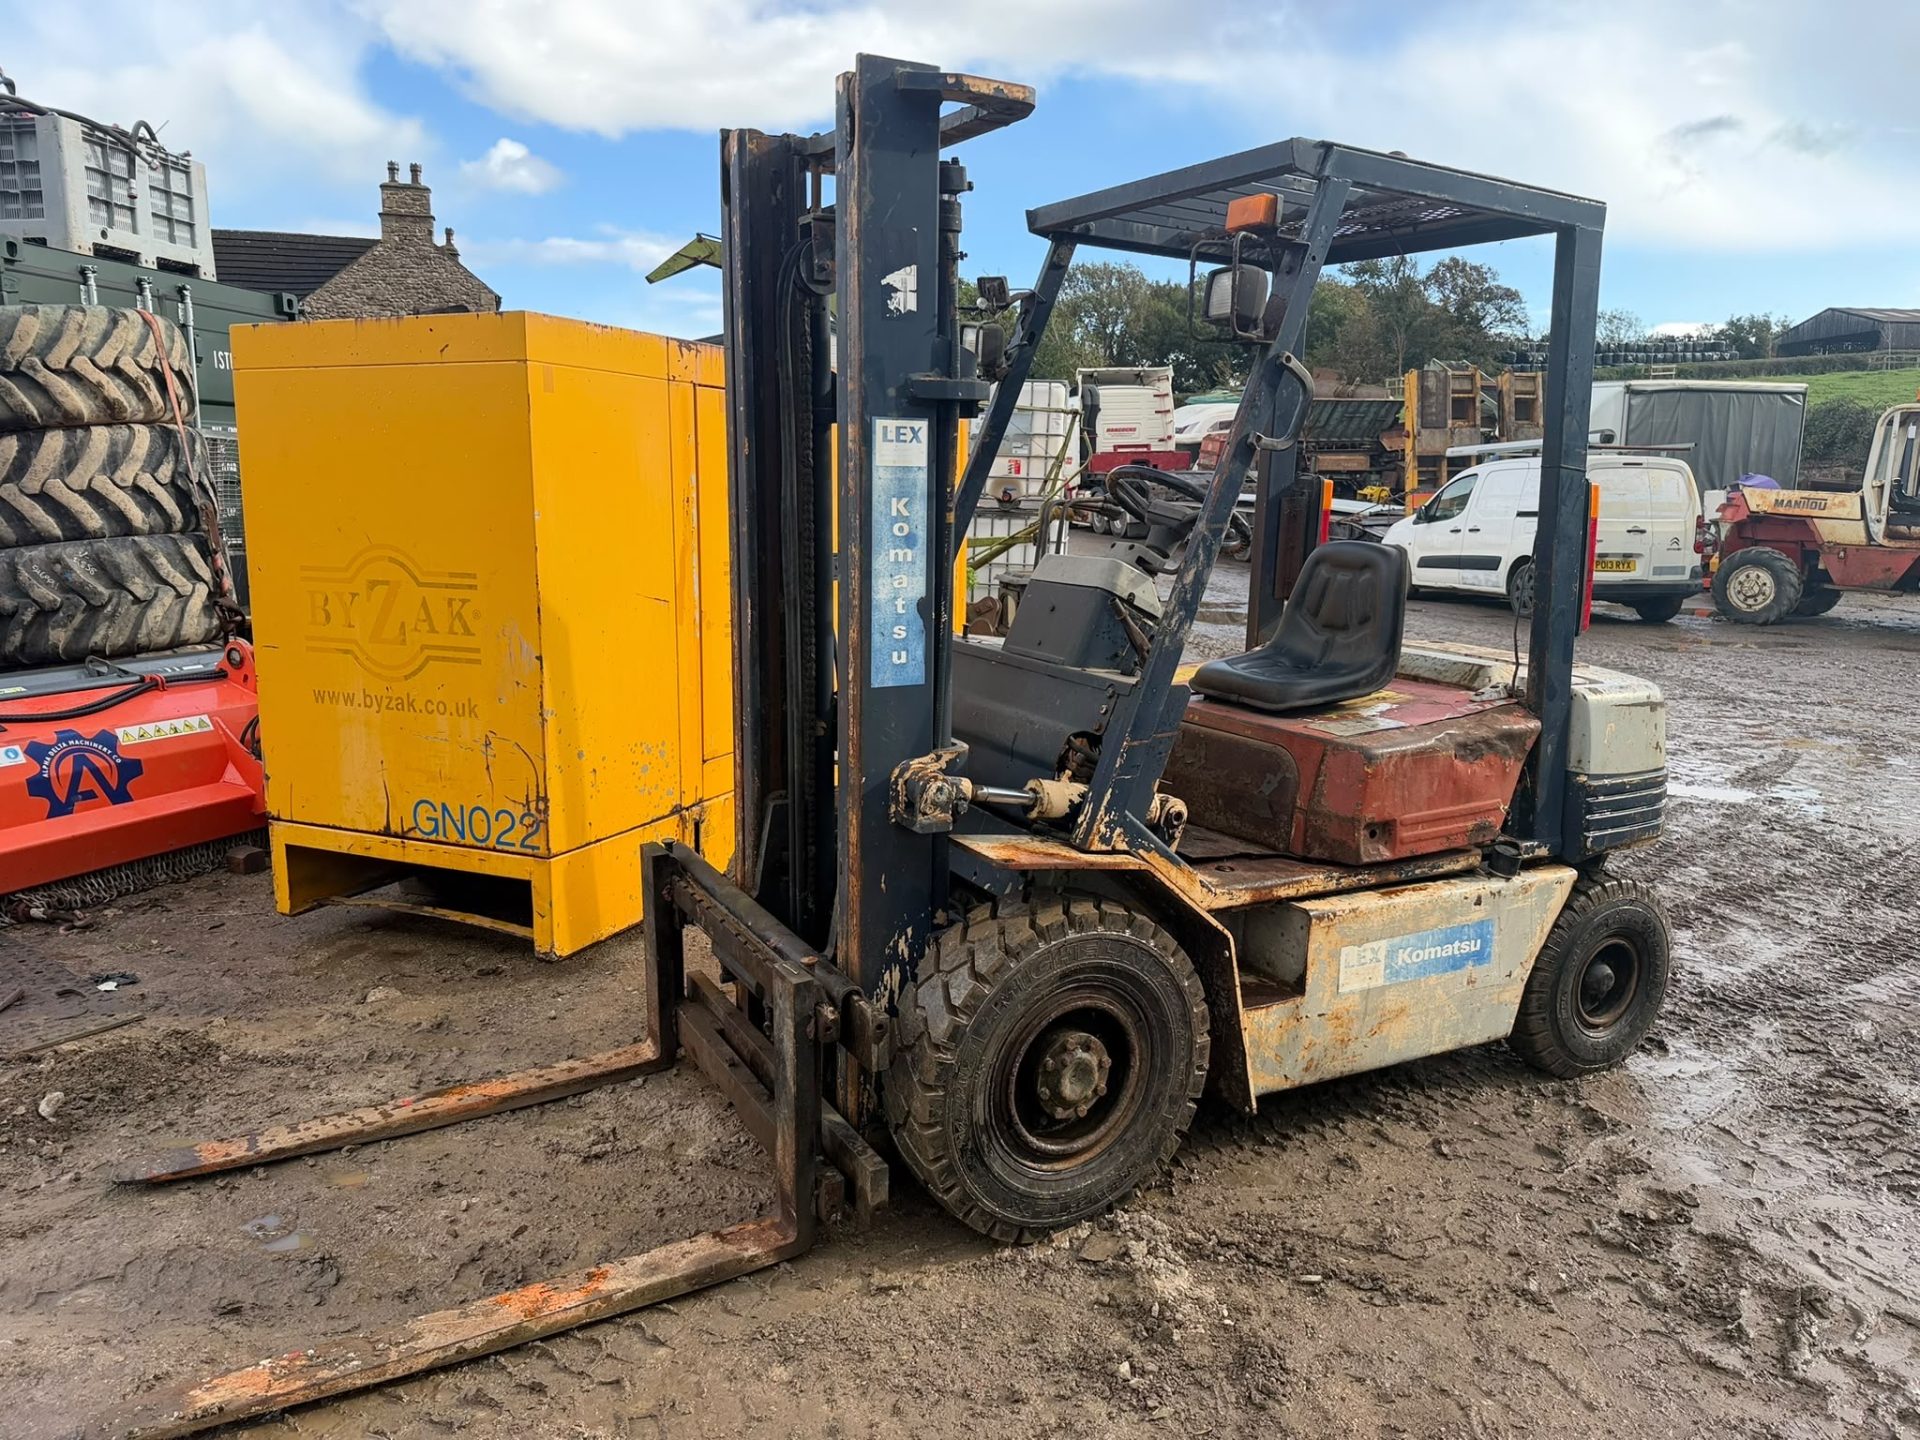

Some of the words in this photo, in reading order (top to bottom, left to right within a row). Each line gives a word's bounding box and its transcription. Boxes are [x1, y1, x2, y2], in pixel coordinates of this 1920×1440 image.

[882, 425, 922, 444] LEX
[1774, 497, 1828, 511] MANITOU
[1615, 560, 1632, 569] RYX
[889, 497, 912, 664] Komatsu
[306, 579, 476, 646] BYZAK
[313, 688, 479, 719] www.byzak.co.uk
[42, 756, 51, 778] ALPHA
[48, 741, 68, 757] DELTA
[68, 740, 112, 755] MACHINERY
[112, 754, 122, 764] CO
[413, 799, 541, 851] GN022
[1397, 938, 1481, 965] Komatsu
